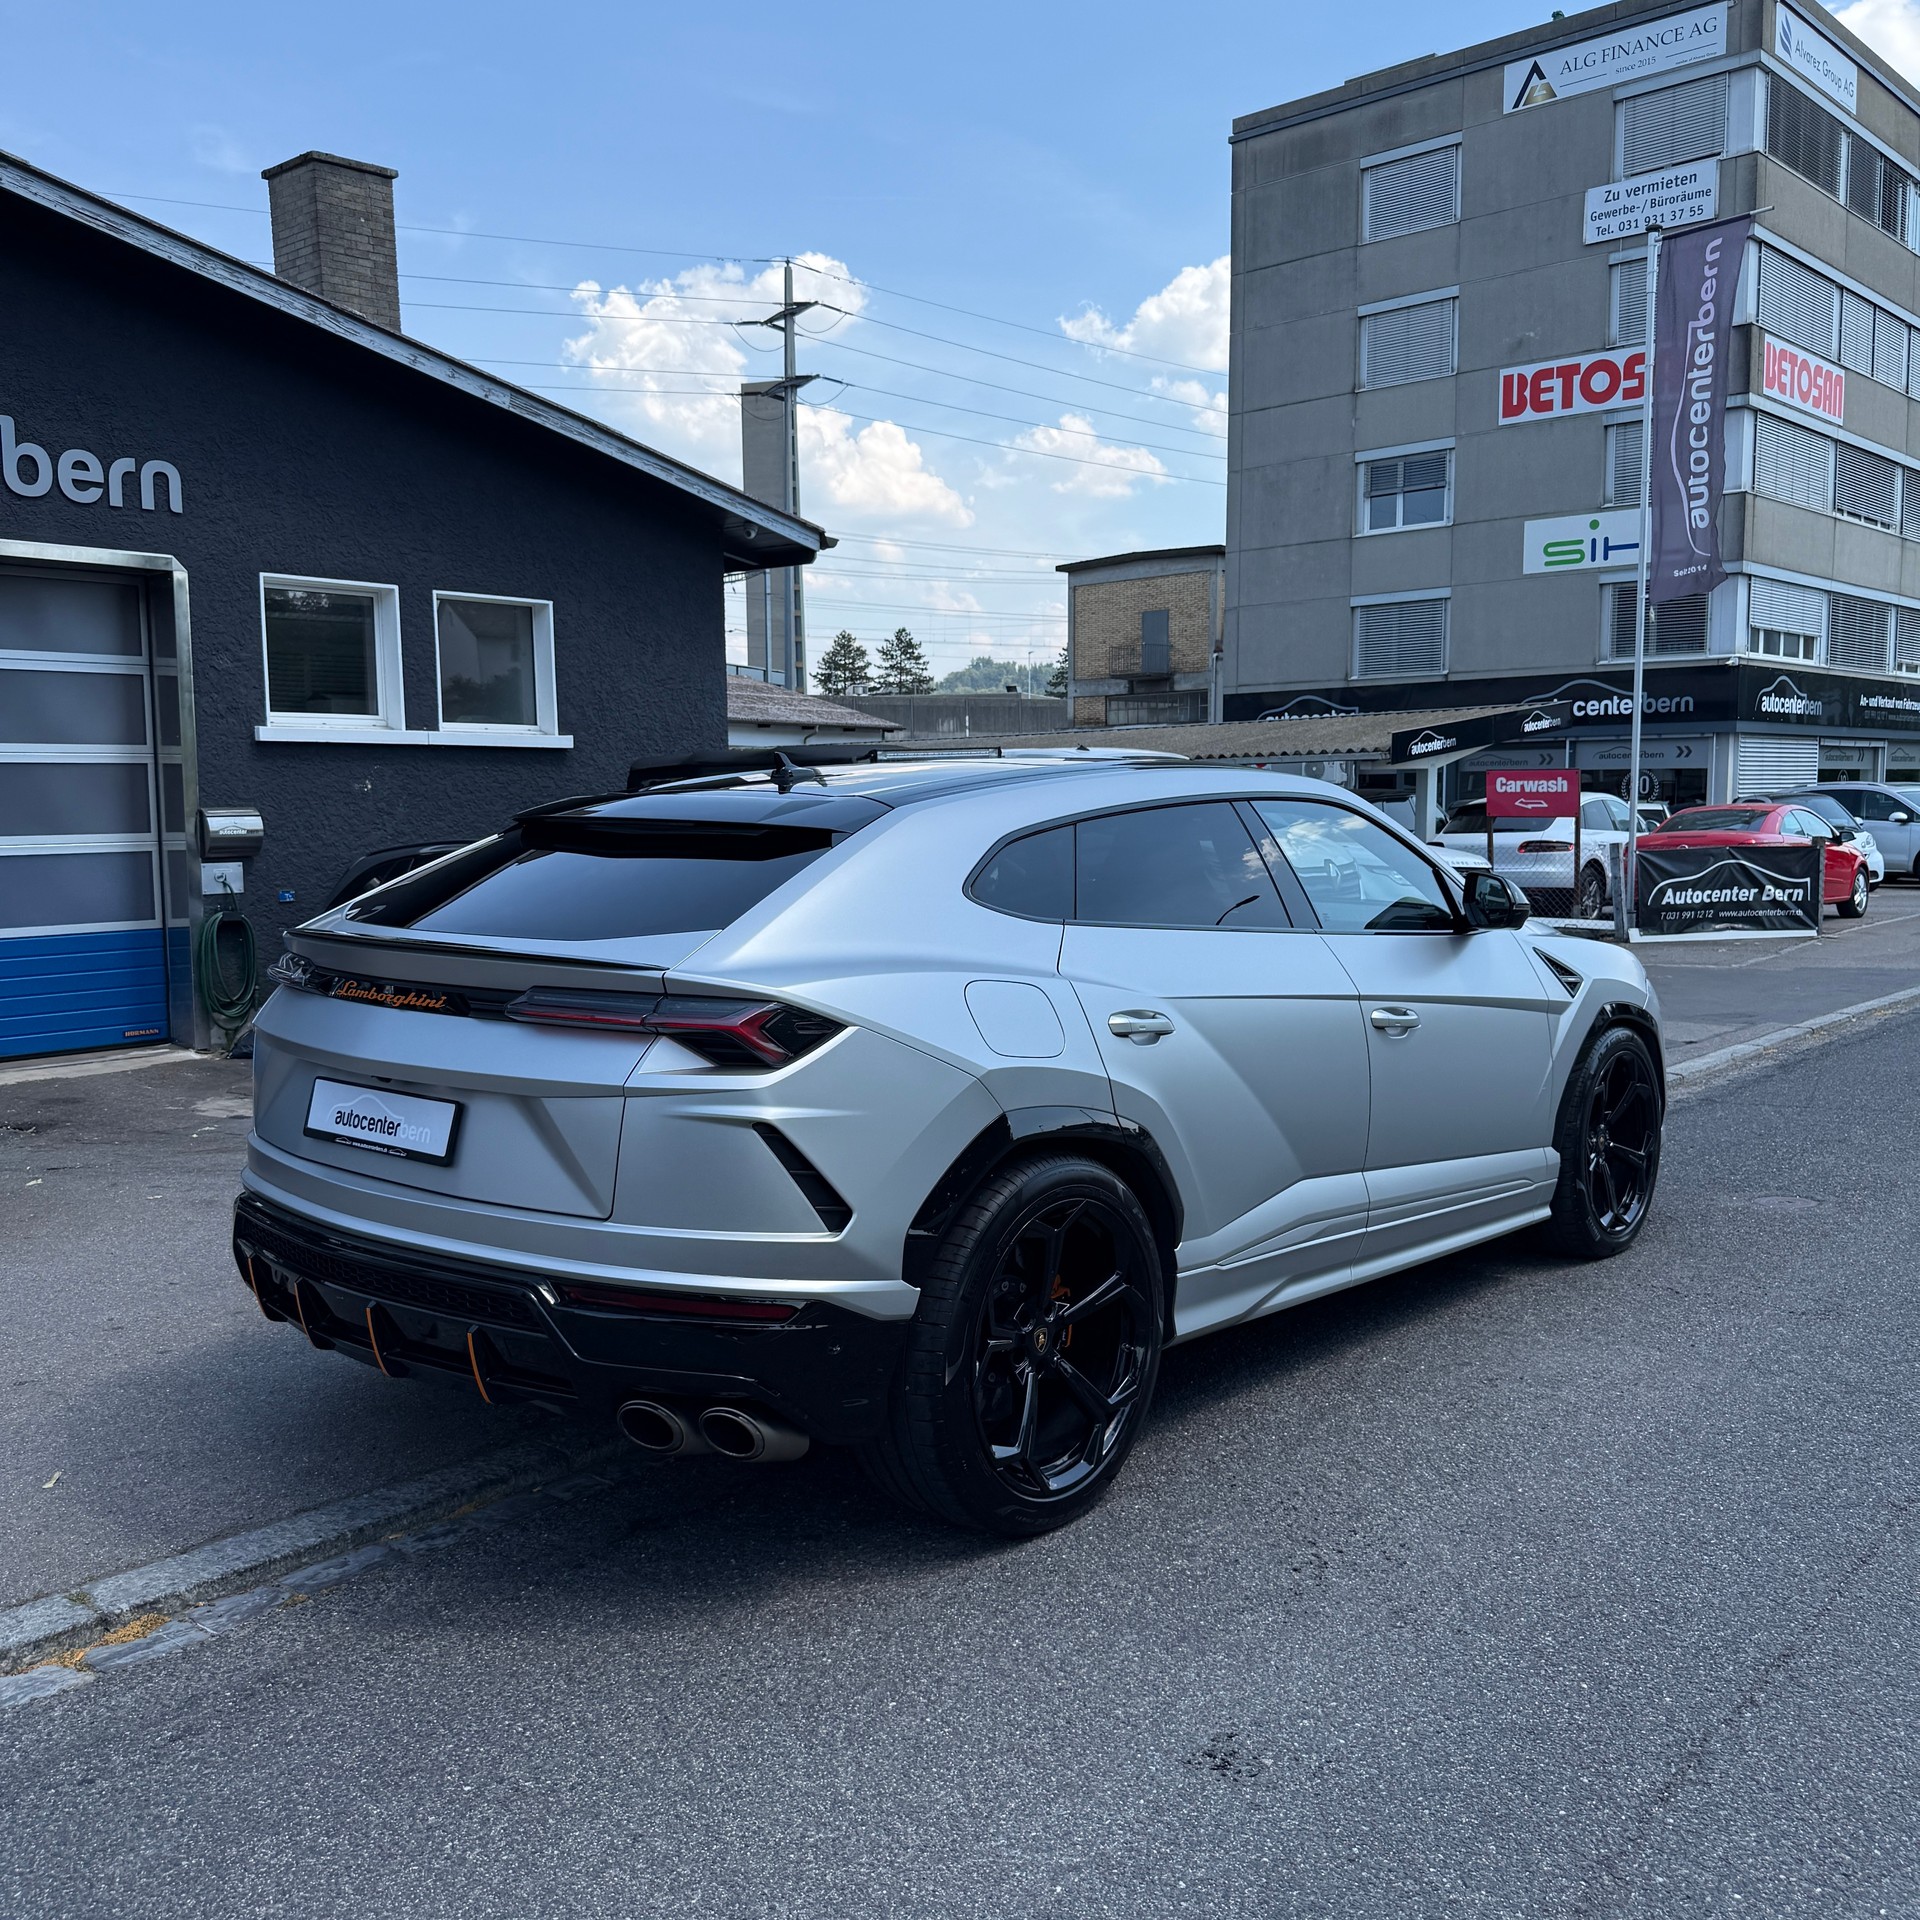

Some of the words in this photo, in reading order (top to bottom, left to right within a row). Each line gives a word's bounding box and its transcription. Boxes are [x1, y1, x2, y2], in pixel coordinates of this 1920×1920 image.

[1559, 52, 1597, 75] ALG
[1601, 26, 1685, 63] FINANCE
[1688, 17, 1718, 38] AG
[1615, 63, 1636, 74] since
[1638, 56, 1656, 71] 2015
[1795, 38, 1821, 72] Alvarez
[1822, 60, 1842, 93] Group
[1843, 78, 1854, 98] AG
[1604, 189, 1620, 203] Zu
[1626, 173, 1697, 198] vermieten
[1595, 226, 1614, 237] Tel.
[1618, 219, 1639, 232] 031
[1644, 213, 1665, 227] 931
[1670, 209, 1684, 221] 37
[1689, 204, 1704, 217] 55
[1502, 351, 1646, 418] BETOS
[1688, 237, 1723, 529] autocenterbern
[1764, 341, 1843, 418] BETOSAN
[1761, 693, 1822, 715] autocenterbern
[1524, 718, 1561, 732] autocenterbern
[1411, 737, 1456, 755] autocenterbern
[1495, 776, 1568, 793] Carwash
[1661, 886, 1758, 906] Autocenter
[1762, 884, 1804, 902] Bern
[1681, 911, 1695, 919] 991
[336, 980, 447, 1009] Lamborghini
[335, 1109, 431, 1144] autocenterbern
